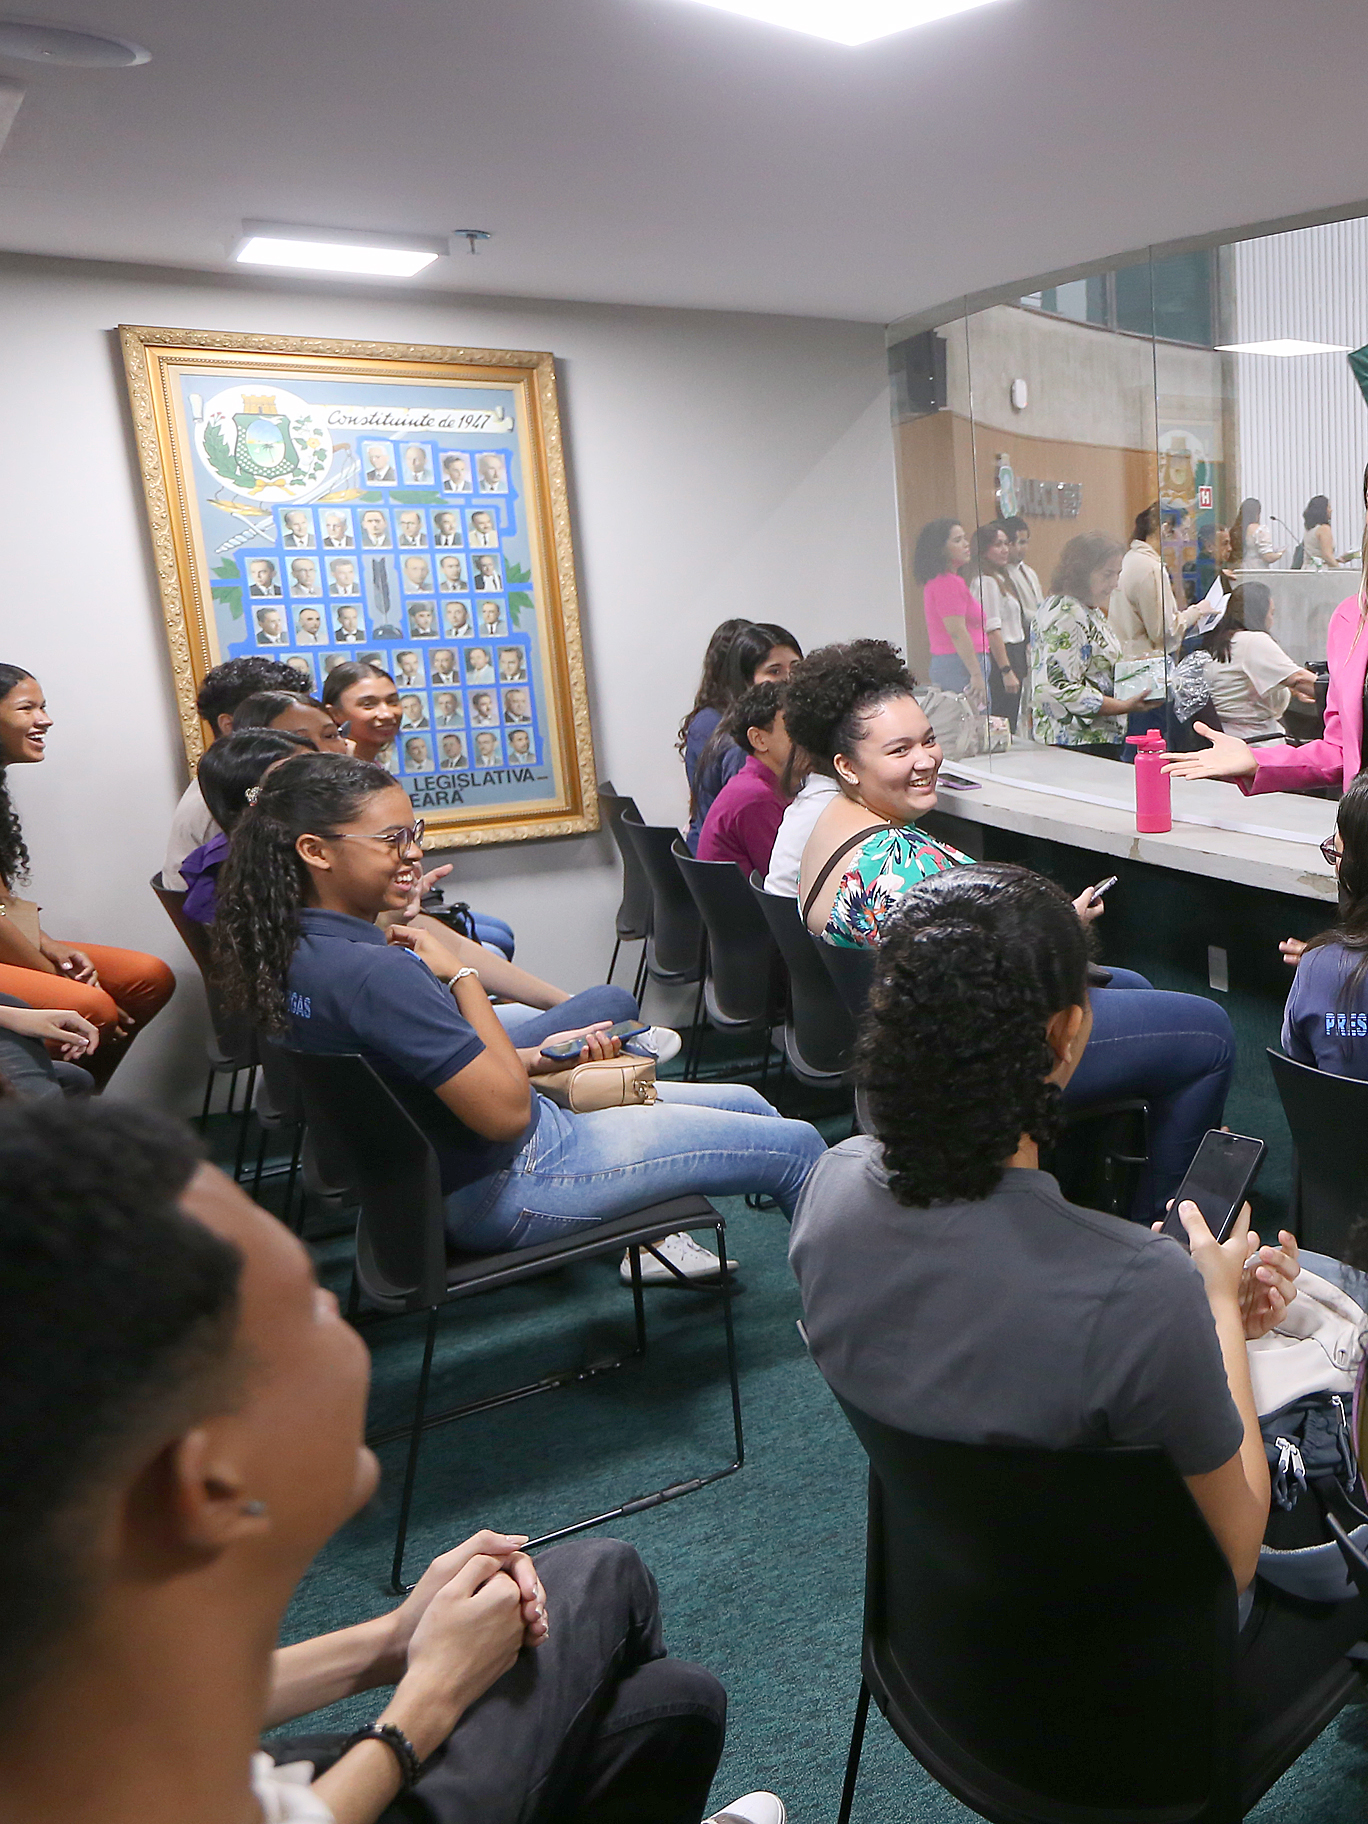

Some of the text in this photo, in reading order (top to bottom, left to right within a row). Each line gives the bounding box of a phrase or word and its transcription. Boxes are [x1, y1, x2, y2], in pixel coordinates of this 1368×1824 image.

[327, 410, 491, 429] Constituinte de 1947
[413, 768, 535, 792] LEGISLATIVA
[409, 787, 464, 808] EARÁ
[287, 991, 311, 1019] GAS
